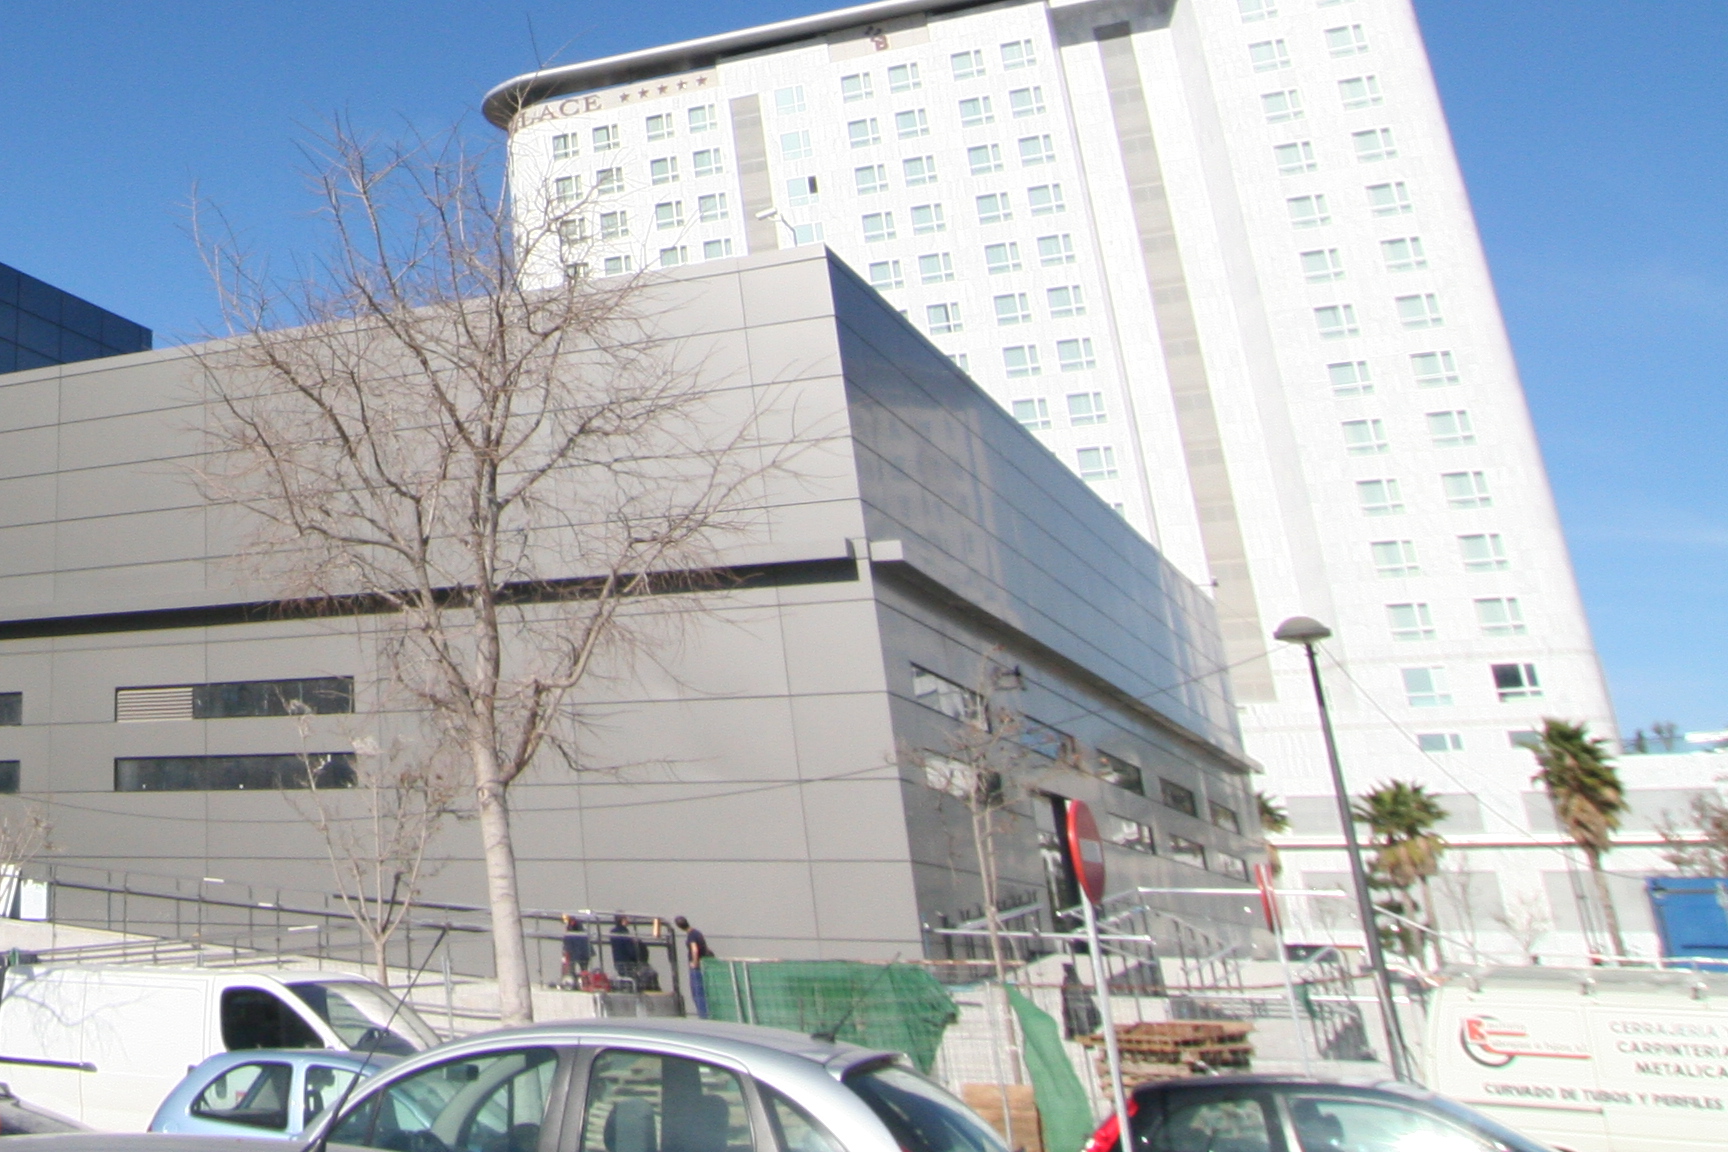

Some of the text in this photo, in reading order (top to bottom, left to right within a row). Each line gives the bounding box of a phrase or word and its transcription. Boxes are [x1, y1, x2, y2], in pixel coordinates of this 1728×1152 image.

[1483, 1082, 1724, 1110] CURVADO DE TUBOS Y PERFILES
